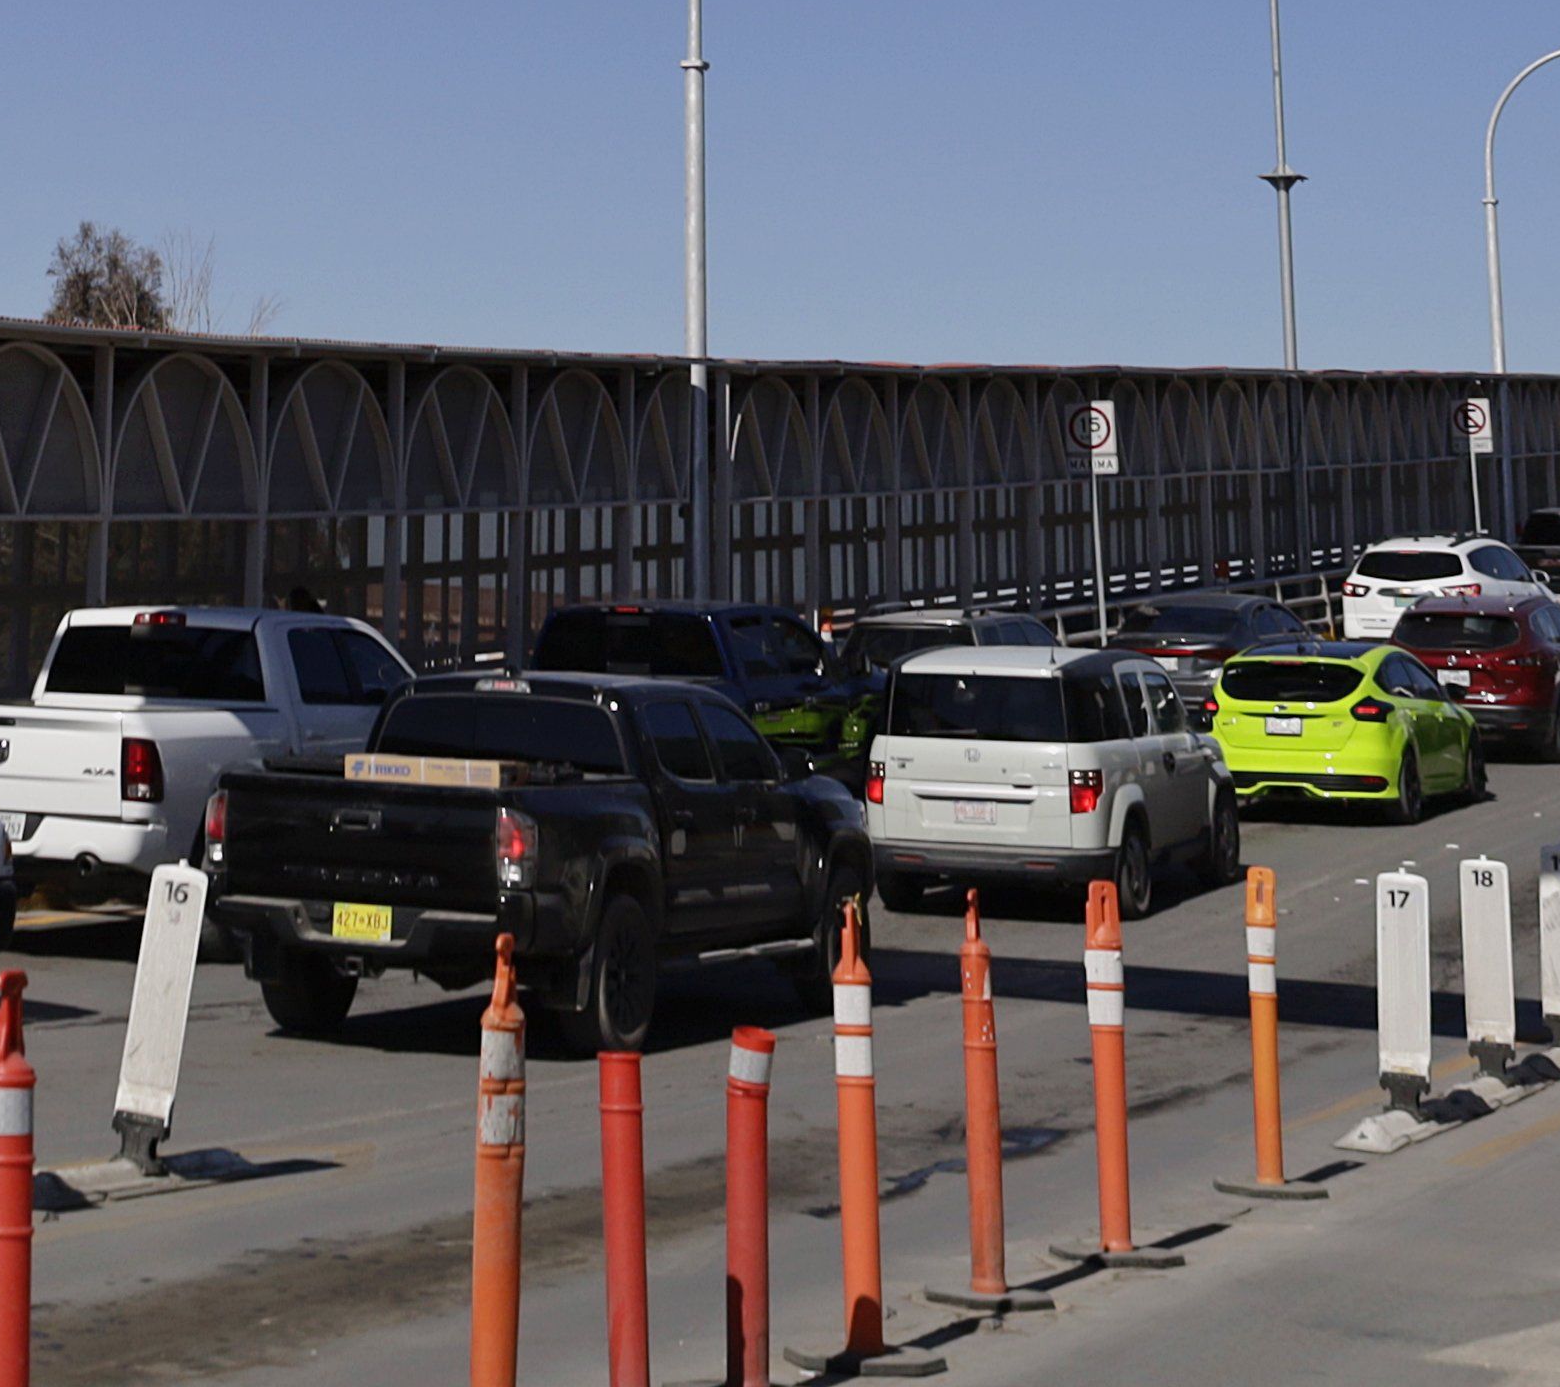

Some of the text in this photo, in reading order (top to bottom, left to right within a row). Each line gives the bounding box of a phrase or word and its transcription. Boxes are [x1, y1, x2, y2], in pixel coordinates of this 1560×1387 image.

[1080, 416, 1101, 433] 15
[1471, 869, 1494, 888] 18
[165, 880, 190, 904] 16
[1387, 889, 1410, 909] 17
